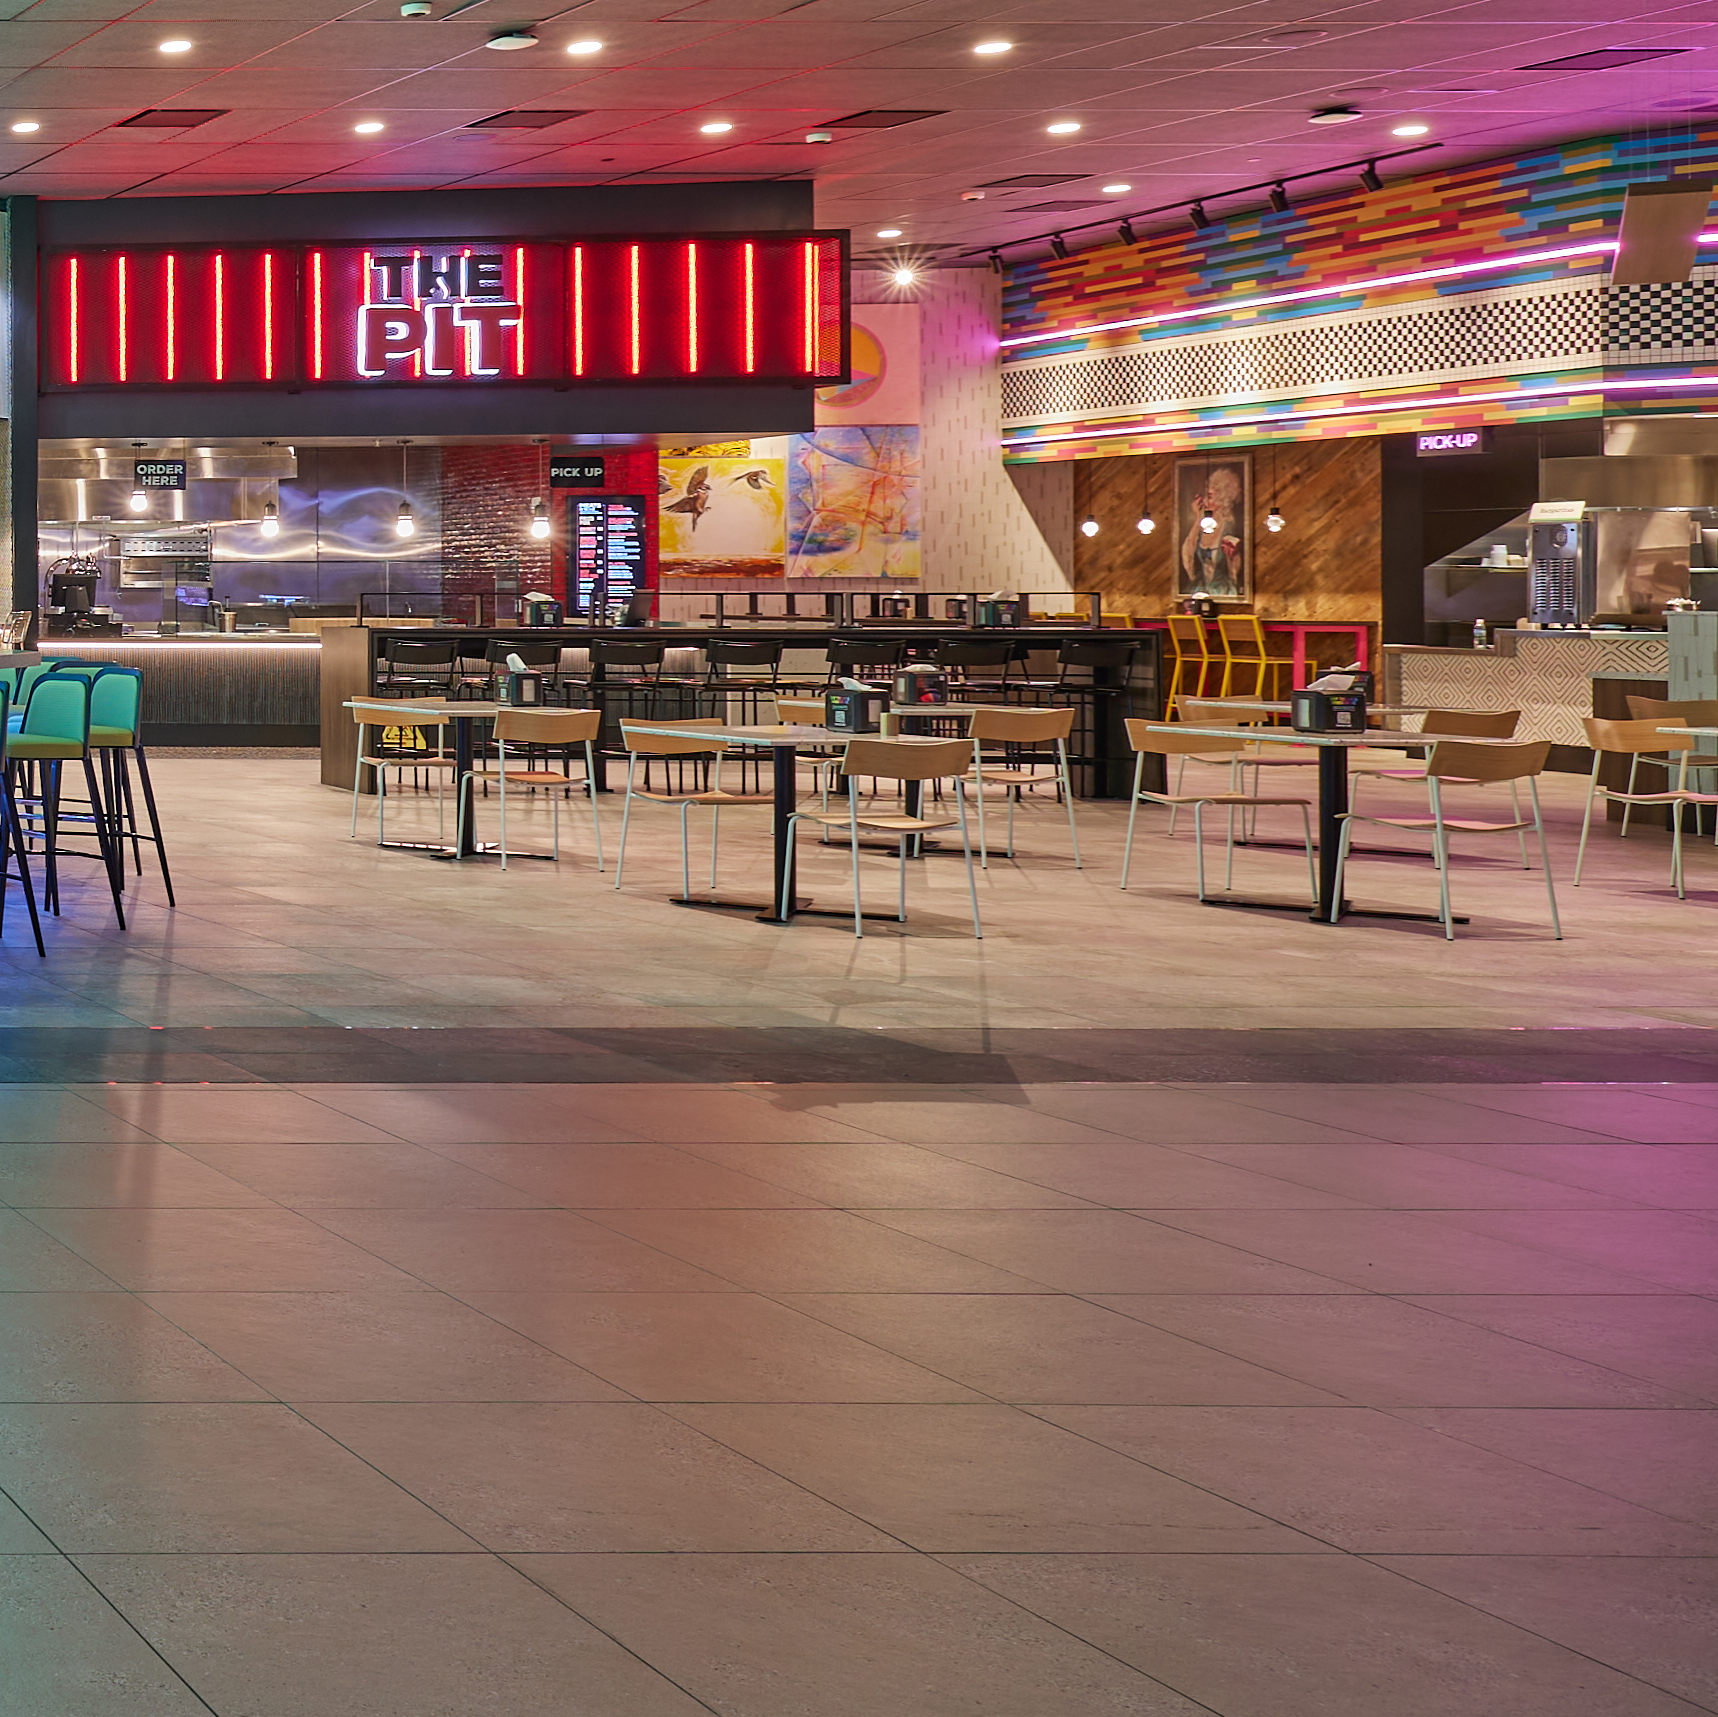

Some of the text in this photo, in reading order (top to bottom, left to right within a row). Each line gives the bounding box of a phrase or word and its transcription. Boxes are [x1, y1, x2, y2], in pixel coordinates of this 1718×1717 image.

[370, 254, 505, 300] THE
[356, 302, 523, 376] PIT
[1419, 432, 1479, 450] PICK-UP
[136, 464, 184, 475] ORDER
[550, 467, 603, 477] PICK UP
[142, 475, 178, 486] HERE
